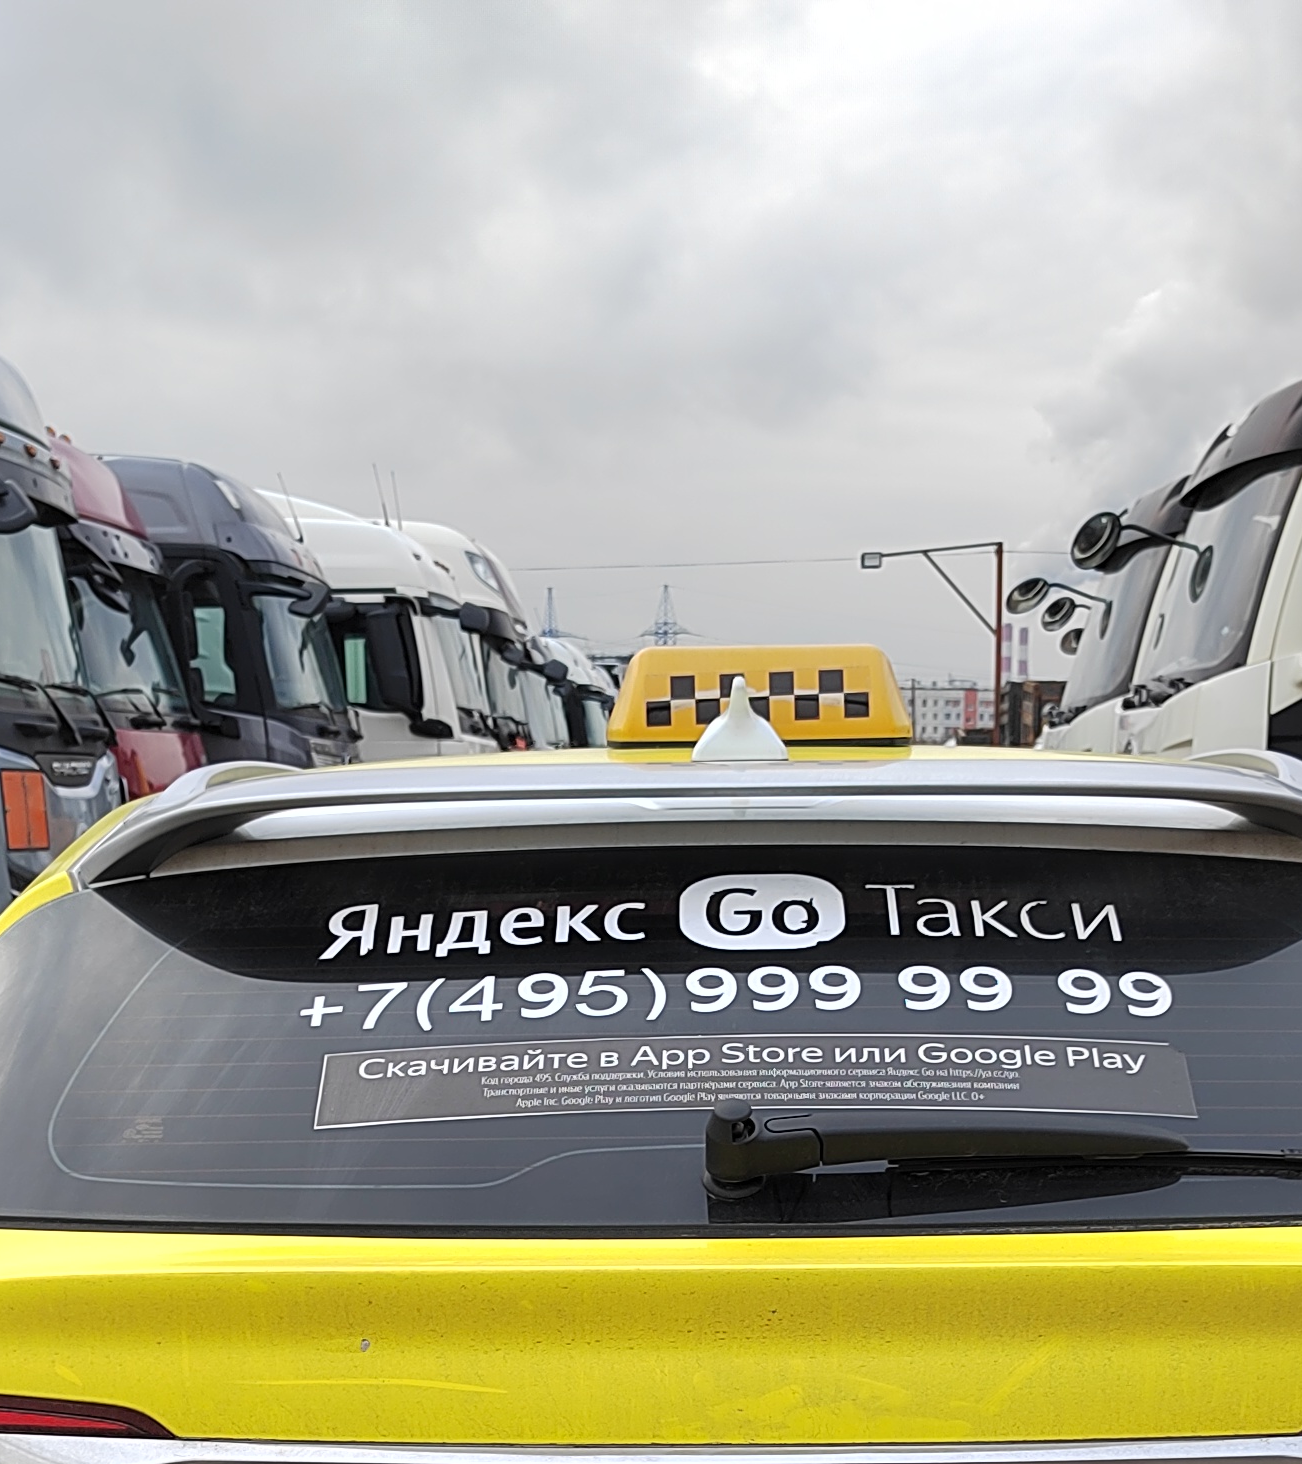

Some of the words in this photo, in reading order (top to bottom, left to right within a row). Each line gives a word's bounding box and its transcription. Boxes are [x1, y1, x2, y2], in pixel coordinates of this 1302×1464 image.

[318, 902, 646, 961] Яндекс
[705, 887, 821, 937] Go
[864, 884, 1123, 942] Такси
[897, 965, 1013, 1012] 99
[1056, 968, 1173, 1018] 99
[357, 1048, 589, 1080] Скачивайте
[600, 1049, 620, 1068] в
[629, 1044, 712, 1070] App
[720, 1042, 824, 1065] Store
[834, 1045, 906, 1064] или
[917, 1042, 1057, 1070] Google
[1065, 1046, 1147, 1075] Play
[481, 1075, 499, 1086] Код
[500, 1075, 533, 1086] города
[554, 1071, 590, 1084] Служба
[647, 1069, 686, 1079] Условия
[848, 1068, 886, 1078] сервиса
[921, 1067, 935, 1077] Go
[936, 1068, 948, 1077] на
[483, 1086, 548, 1098] Транспортные
[584, 1084, 616, 1095] услуги
[779, 1078, 798, 1090] App
[799, 1078, 823, 1088] Store
[973, 1081, 1020, 1090] компании
[515, 1097, 542, 1109] Apple
[561, 1094, 594, 1106] Google
[594, 1094, 615, 1106] Play
[623, 1094, 662, 1103] логотип
[663, 1091, 696, 1103] Google
[697, 1091, 716, 1102] Play
[917, 1090, 950, 1102] Google
